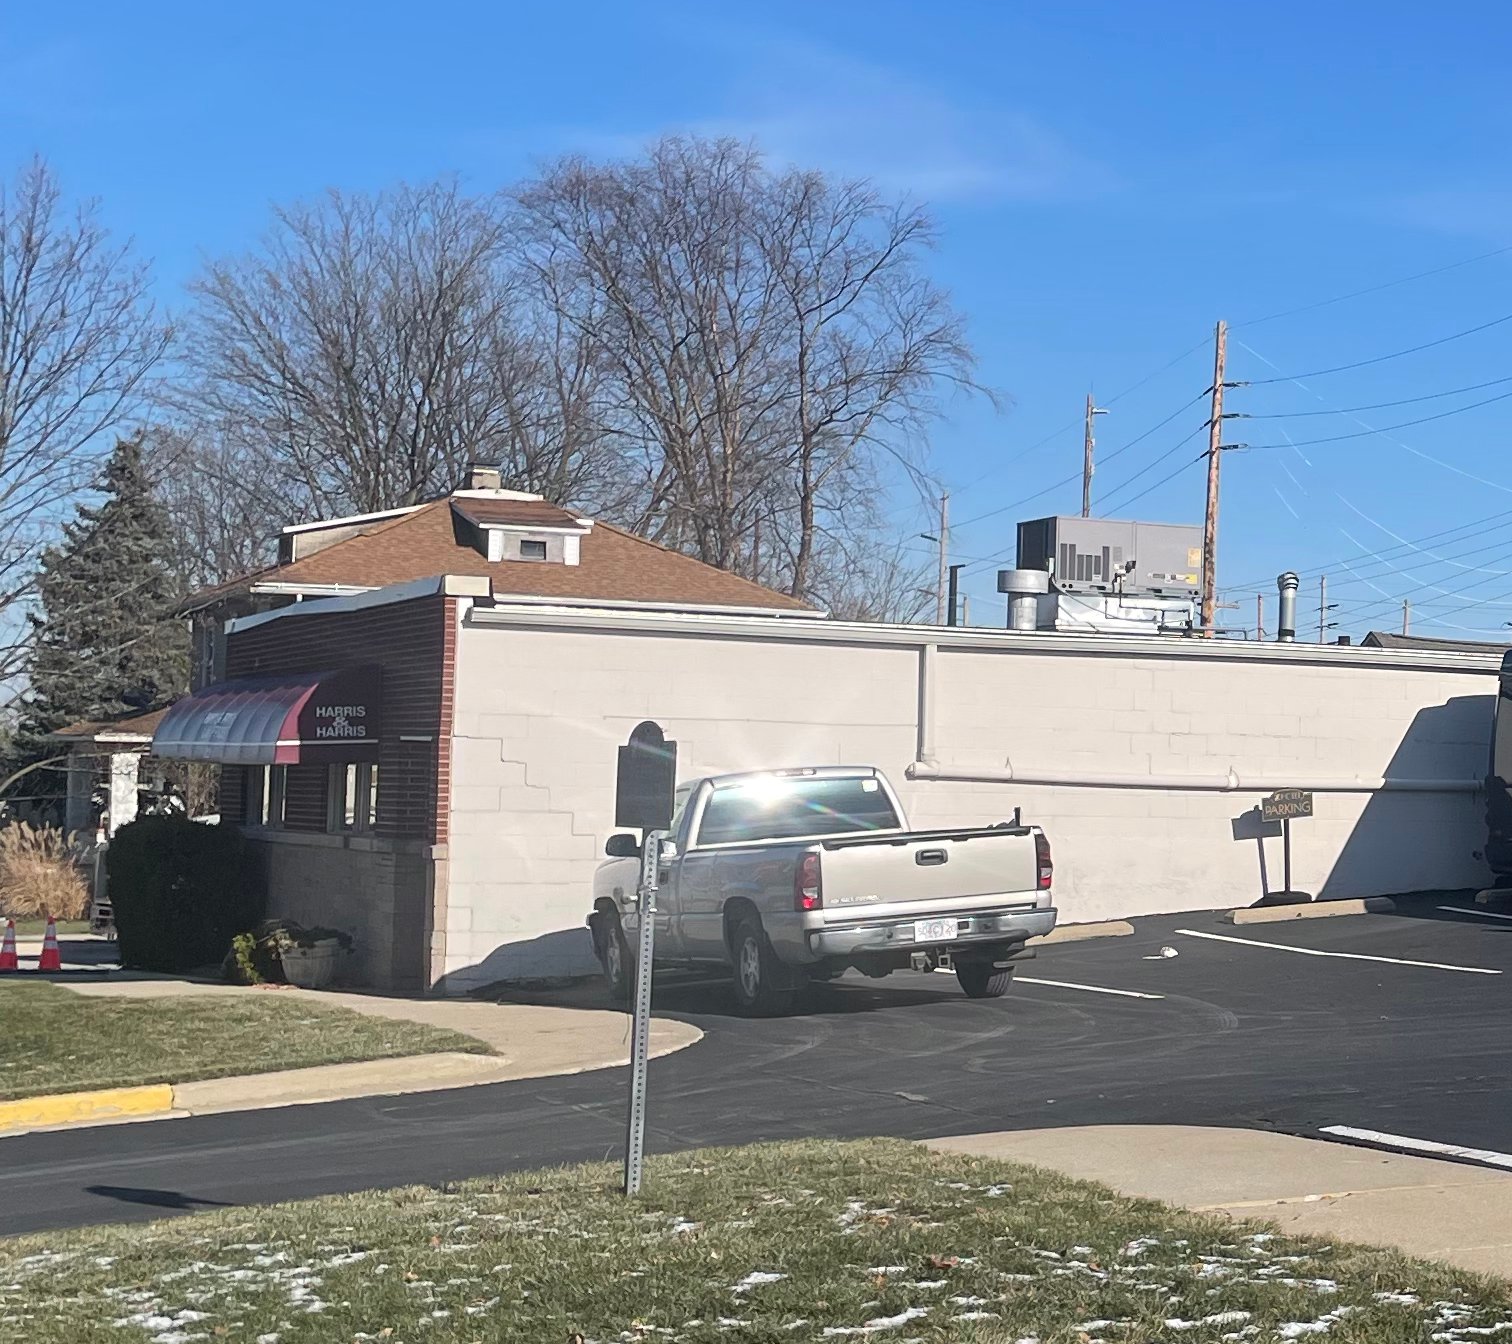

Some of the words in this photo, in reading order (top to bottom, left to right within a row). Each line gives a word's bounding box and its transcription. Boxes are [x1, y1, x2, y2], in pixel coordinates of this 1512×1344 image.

[316, 706, 366, 718] HARRIS
[332, 716, 349, 728] &
[316, 726, 366, 738] HARRIS
[1265, 800, 1311, 816] PARKING
